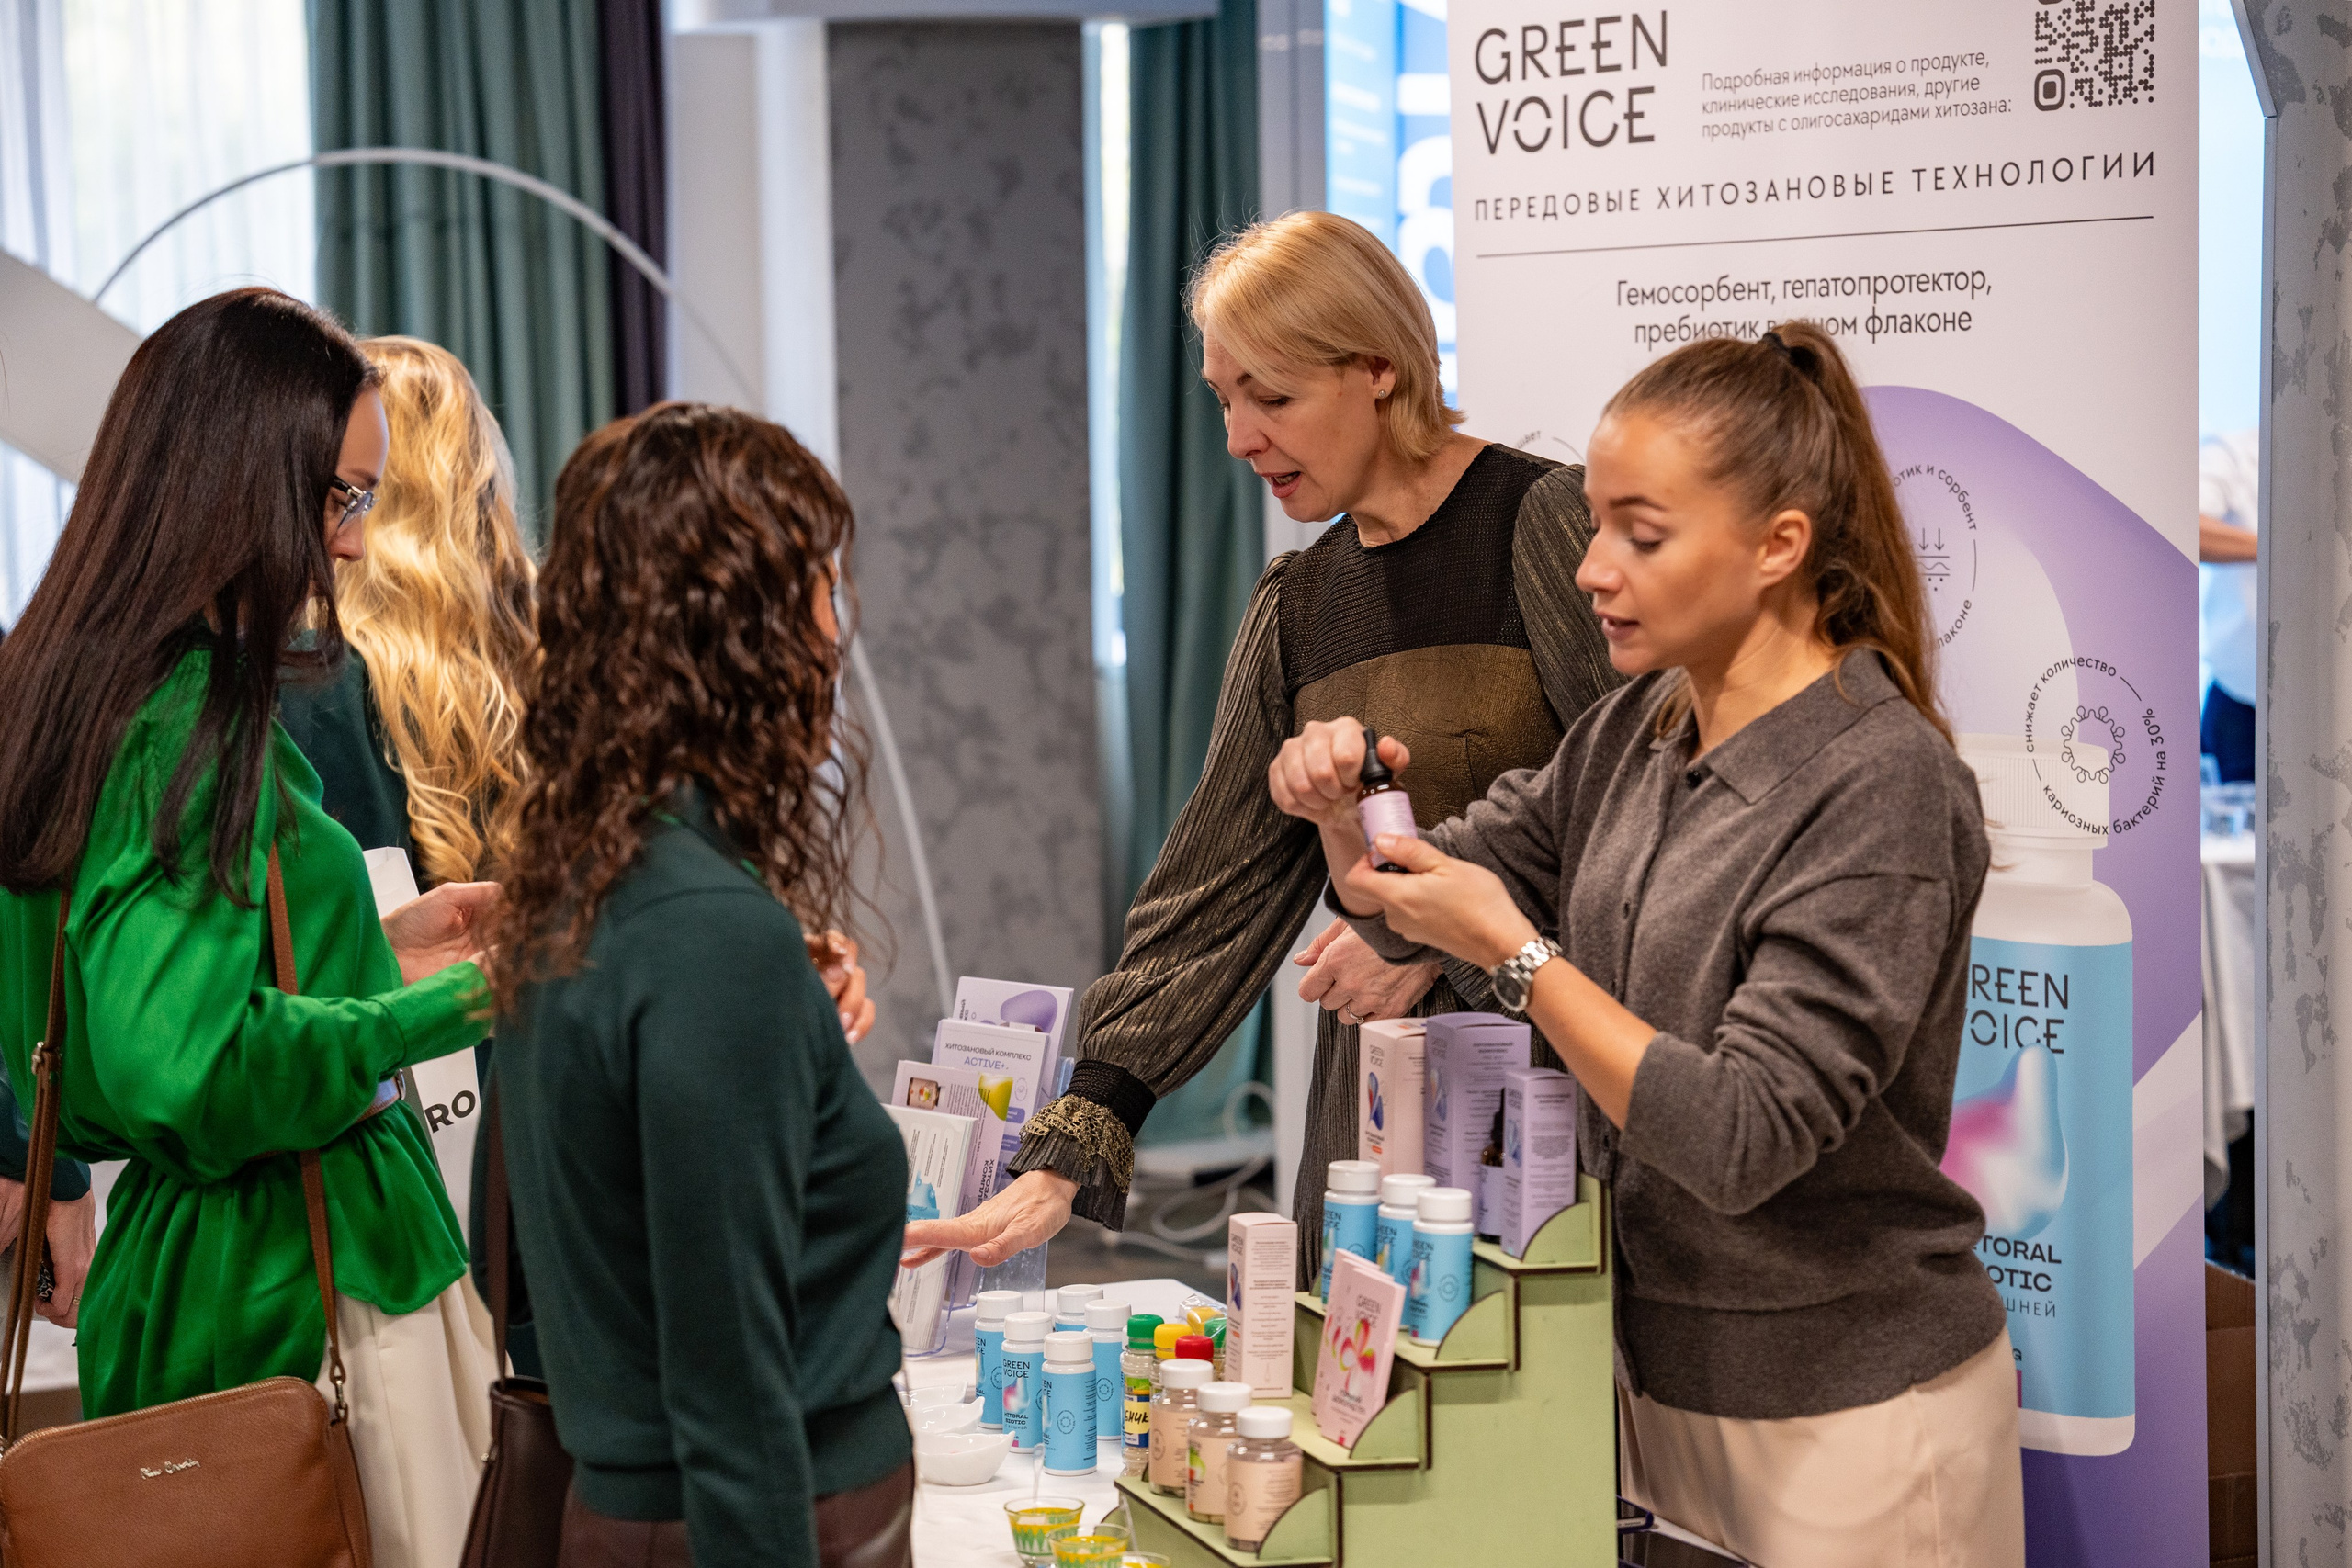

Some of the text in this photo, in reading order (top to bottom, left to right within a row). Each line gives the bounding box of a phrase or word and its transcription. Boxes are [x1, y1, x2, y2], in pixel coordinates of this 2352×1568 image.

[1475, 10, 1667, 85] GREEN
[1702, 51, 1990, 93] Подробная информация о продукте,
[1702, 75, 1980, 115] клинические исследования, другие
[1476, 85, 1655, 154] VOICE
[1702, 98, 2012, 141] продукты с олигосахаридами хитозана:
[1475, 151, 2154, 221] ПЕРЕДОВЫЕ ХИТОЗАНОВЫЕ ТЕХНОЛОГИИ
[1616, 269, 1993, 311] Гемосорбент, гепатопротектор,
[1634, 315, 1758, 351] пребиотик
[1865, 306, 1973, 344] флаконе
[1926, 464, 1934, 476] и
[1938, 469, 1977, 531] сорбент
[1936, 599, 1973, 649] лаконе
[2025, 656, 2117, 753] снижает количество
[2042, 708, 2166, 835] кариозных бактерий на 30%
[1972, 964, 2069, 1010] REEN
[944, 1043, 1032, 1061] ХИТОЗАНОВЫЙ КОМПЛЕКС
[1968, 1010, 2064, 1055] OICE
[984, 1158, 995, 1199] ХИТОЗА
[1981, 1235, 2062, 1264] TORAL
[1984, 1265, 2052, 1292] OTIC
[1002, 1359, 1031, 1370] GREEN
[1003, 1370, 1030, 1379] VOICE
